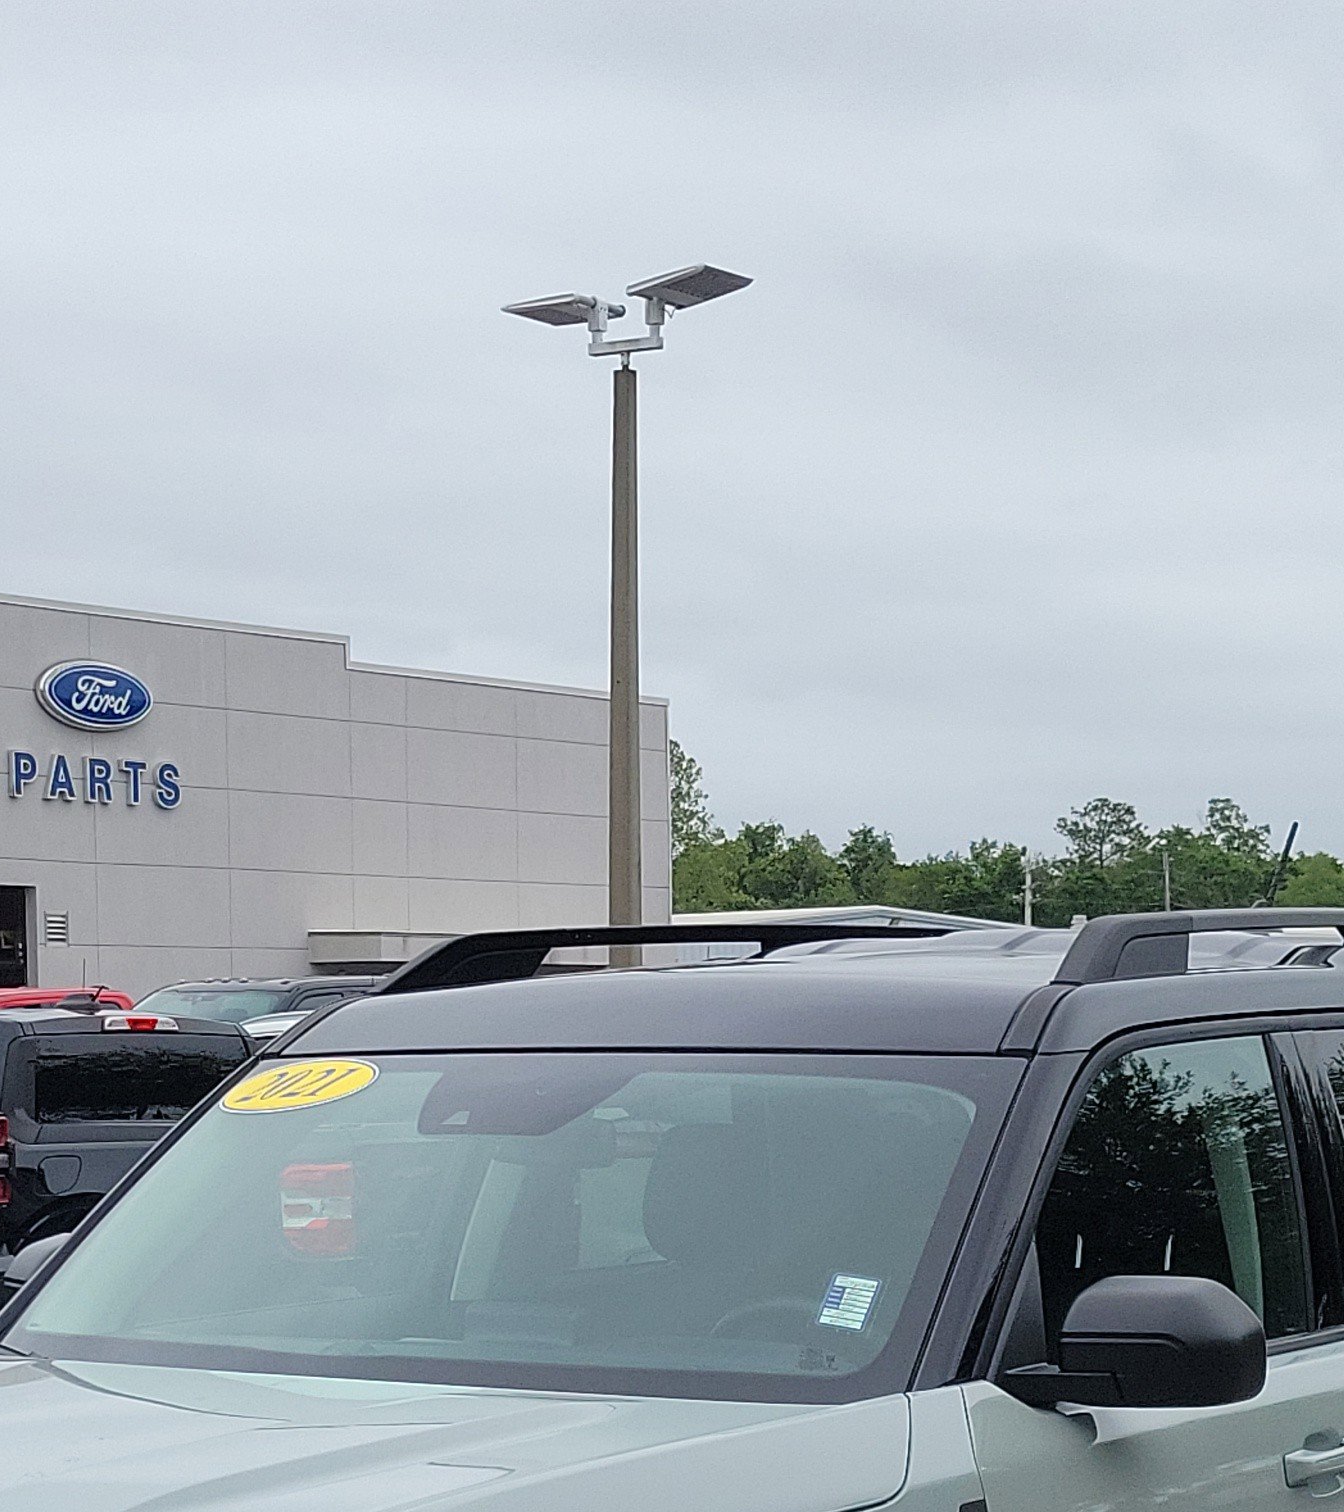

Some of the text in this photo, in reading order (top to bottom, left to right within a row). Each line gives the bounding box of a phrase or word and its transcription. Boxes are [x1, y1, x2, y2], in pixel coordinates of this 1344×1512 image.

[71, 674, 131, 715] Ford
[10, 751, 181, 809] PARTS
[235, 1067, 362, 1103] 2021
